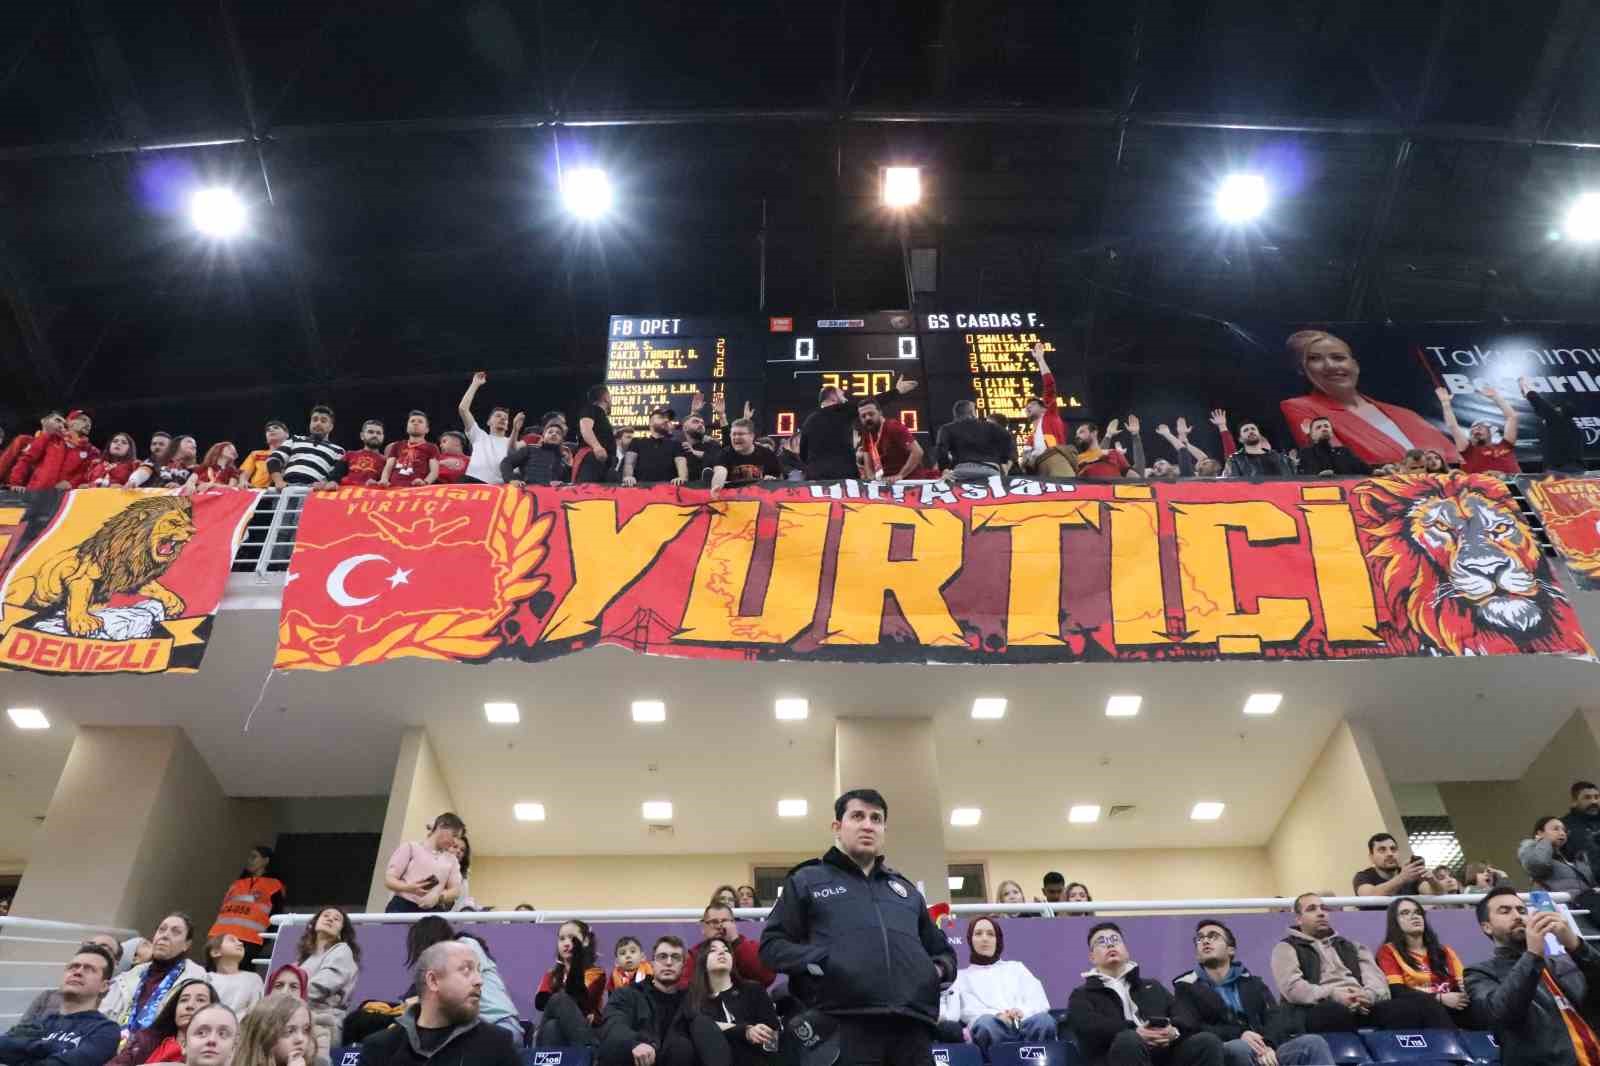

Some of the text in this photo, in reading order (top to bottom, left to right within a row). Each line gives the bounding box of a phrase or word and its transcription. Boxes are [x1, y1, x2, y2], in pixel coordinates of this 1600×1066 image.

[612, 319, 680, 335] FB OPET
[928, 313, 1045, 328] GS CAGDAS F.
[796, 338, 813, 360] 0
[899, 337, 916, 358] 0
[976, 398, 984, 408] 8
[777, 412, 794, 434] 0
[901, 410, 918, 431] 0
